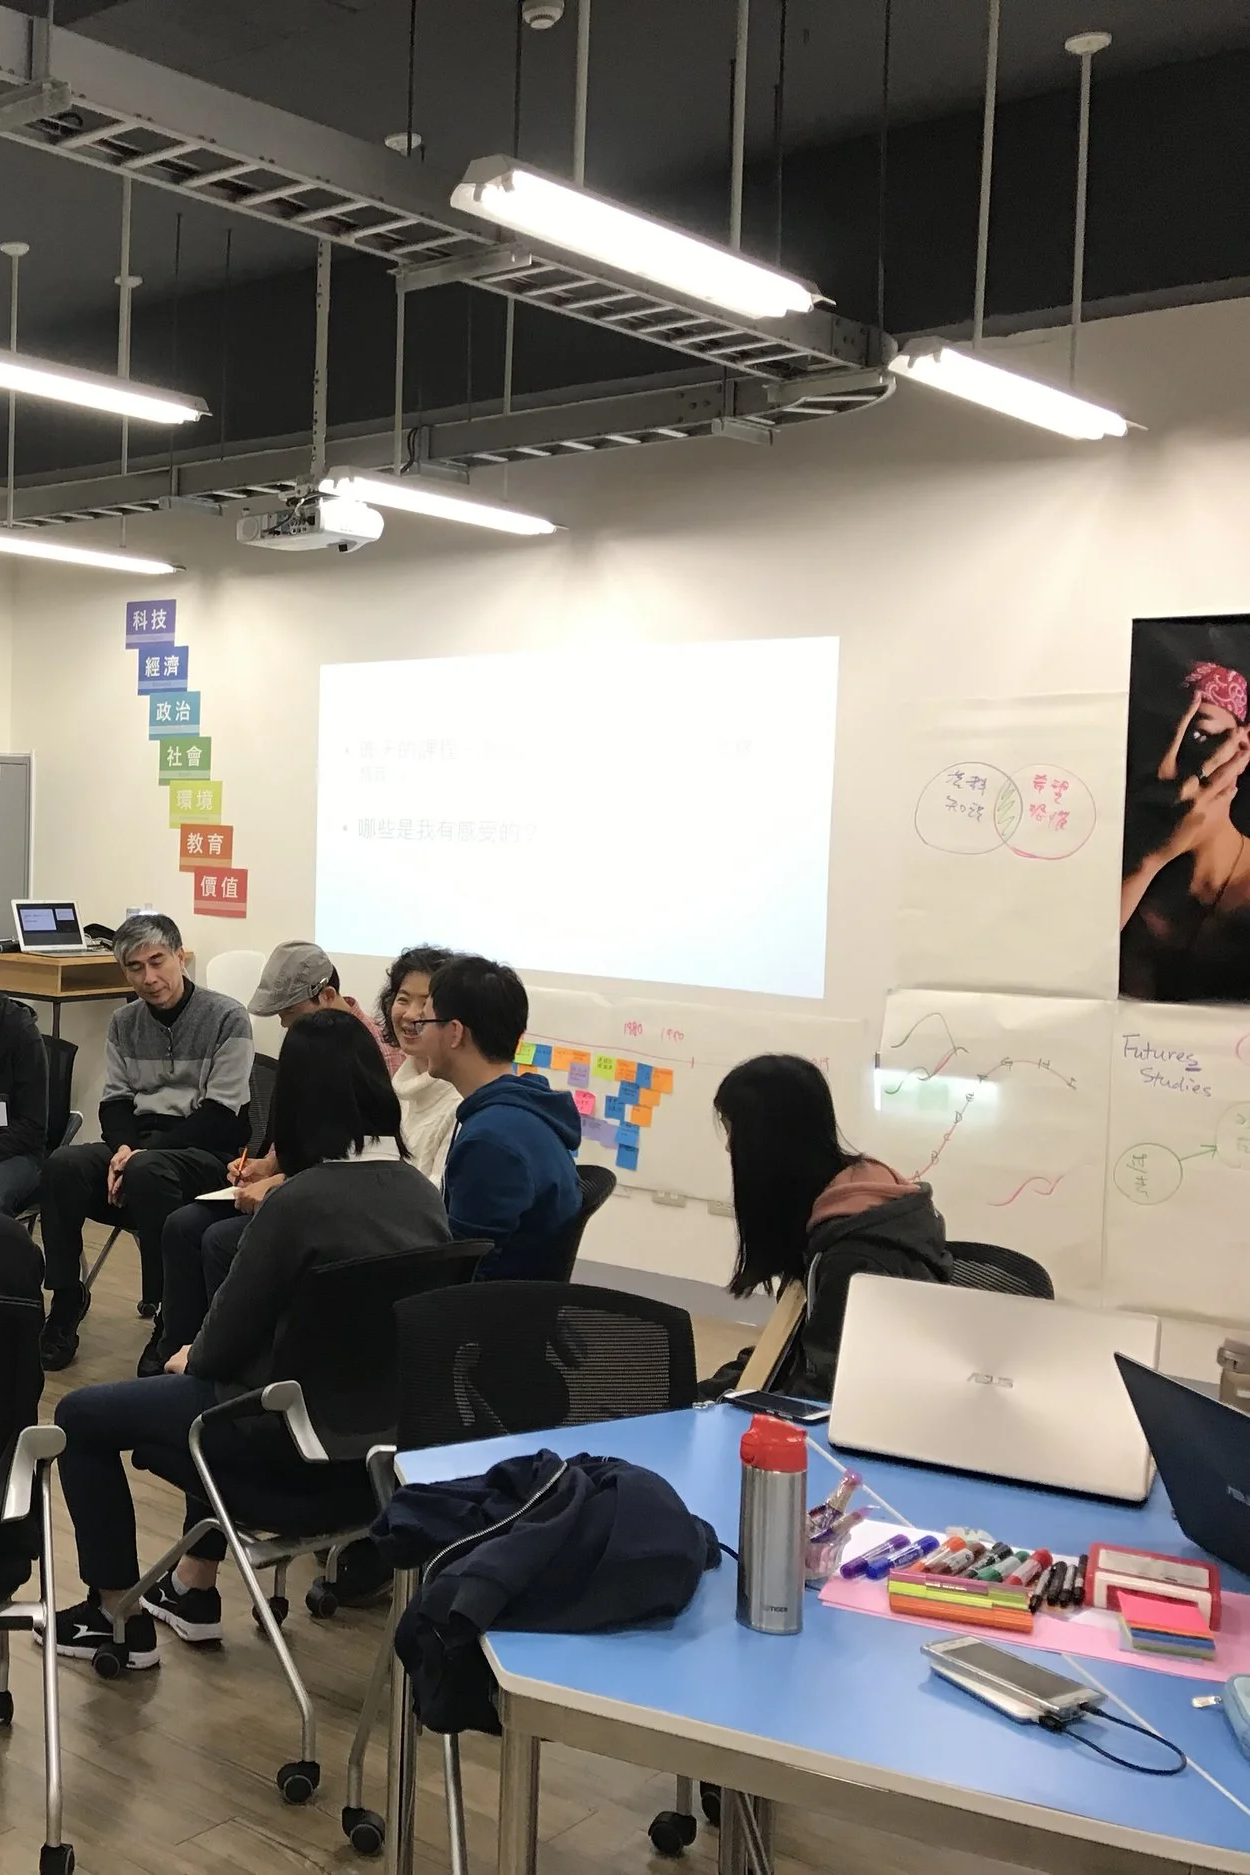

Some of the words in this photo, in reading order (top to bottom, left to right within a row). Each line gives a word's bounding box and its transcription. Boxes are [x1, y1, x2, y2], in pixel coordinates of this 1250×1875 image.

[132, 608, 167, 631] 科技
[144, 655, 180, 678] 經濟
[155, 700, 191, 722] 政治
[166, 745, 203, 768] 社會
[176, 790, 214, 811] 環境
[186, 832, 224, 855] 教育
[200, 875, 239, 899] 價值
[1122, 1034, 1200, 1067] Futures
[1140, 1067, 1212, 1098] Studies
